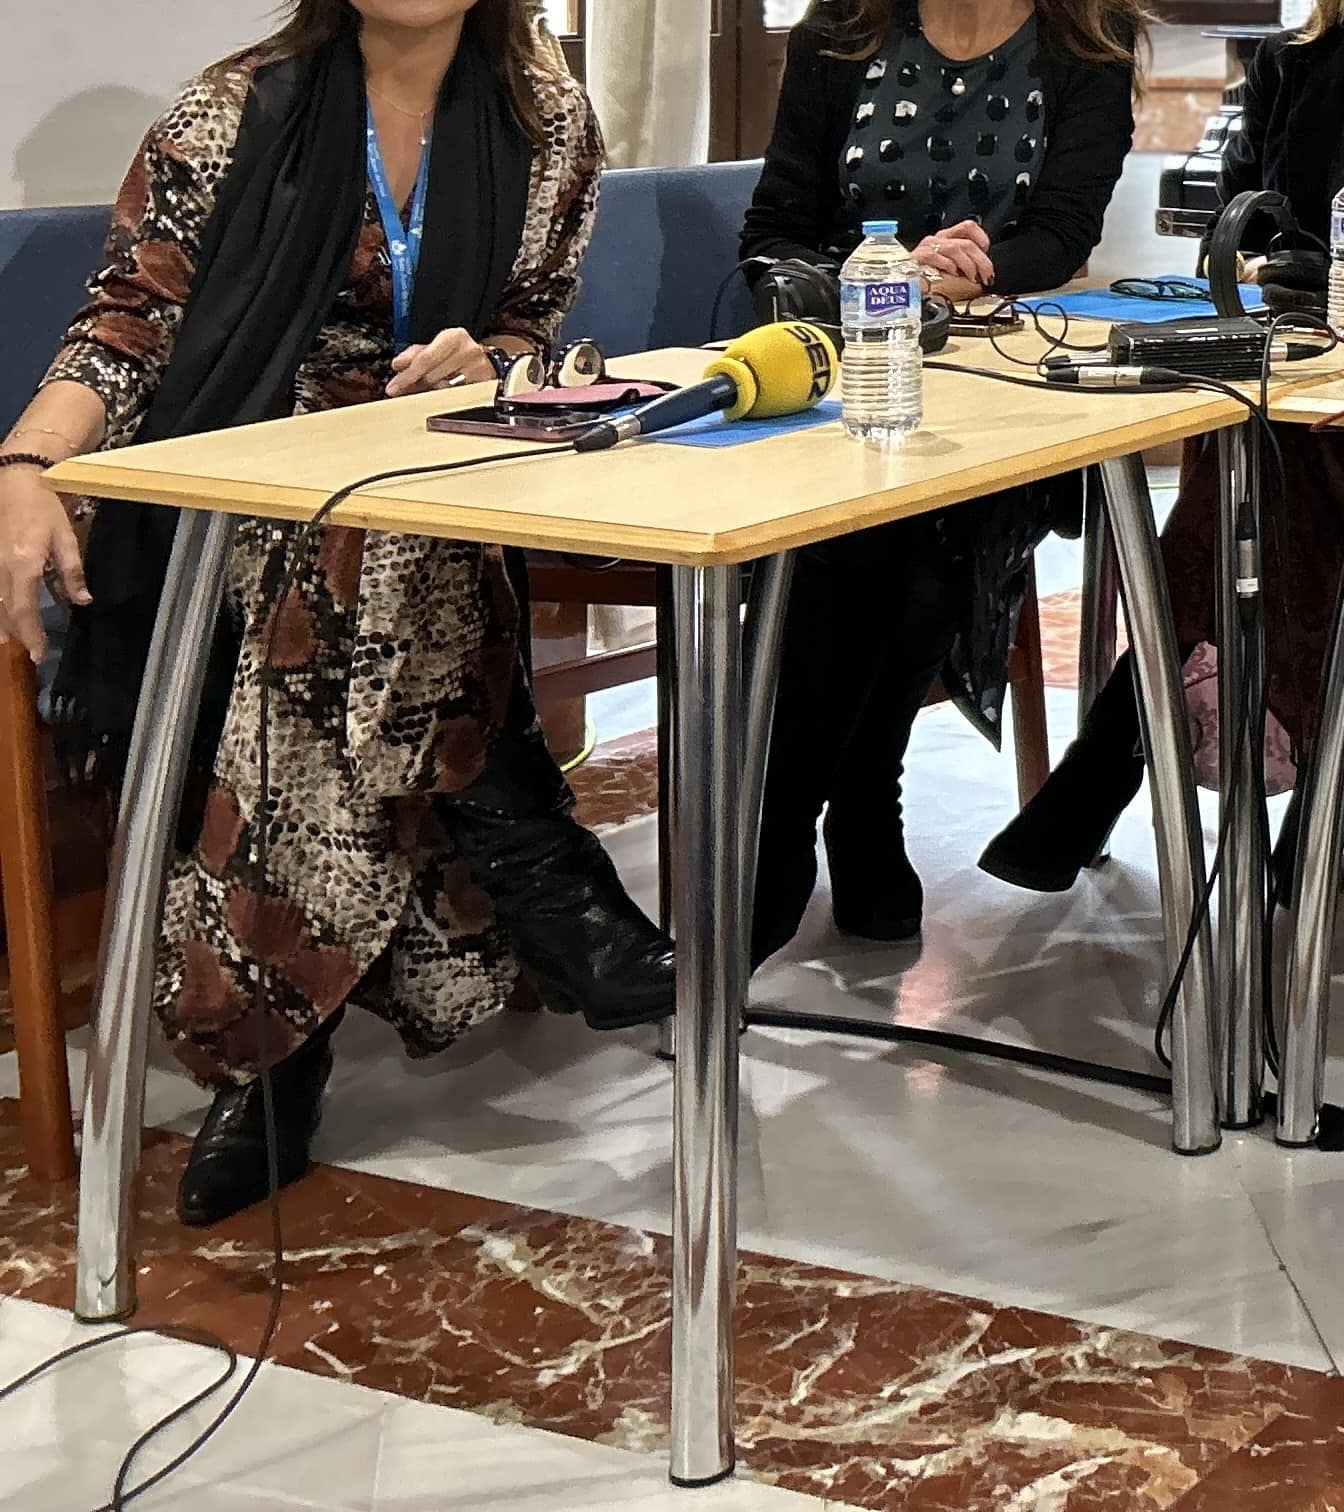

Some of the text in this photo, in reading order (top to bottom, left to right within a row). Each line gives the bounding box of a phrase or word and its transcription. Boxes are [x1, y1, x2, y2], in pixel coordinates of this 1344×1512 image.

[871, 285, 907, 296] AQUA
[871, 295, 906, 305] DEUS
[783, 325, 831, 402] SER
